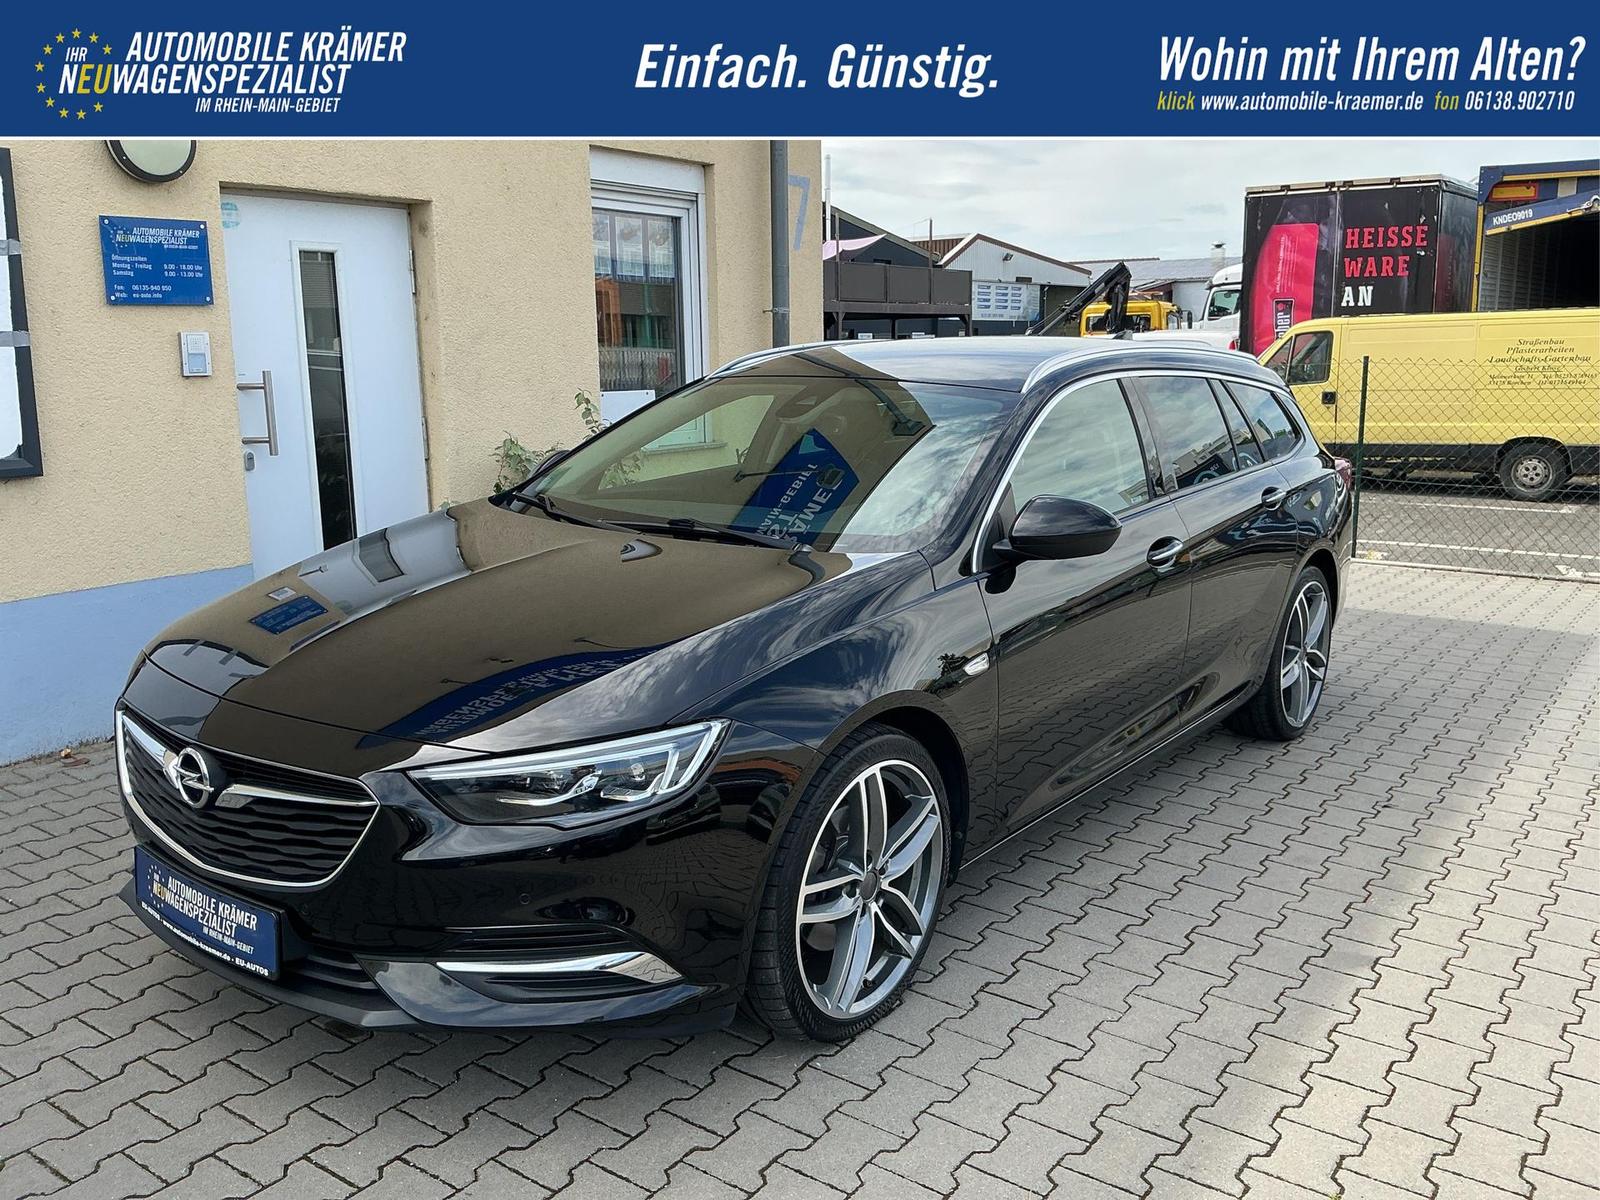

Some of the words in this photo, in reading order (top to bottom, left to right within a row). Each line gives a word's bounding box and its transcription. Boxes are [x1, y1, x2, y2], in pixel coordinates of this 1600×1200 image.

[116, 234, 187, 244] NEUWAGENSPEZIALIST
[132, 227, 173, 237] AUTOMOBILE
[174, 228, 200, 238] KRÄMER
[1345, 225, 1429, 249] HEISSE
[1343, 255, 1410, 278] WARE
[1341, 285, 1374, 307] AN
[1506, 346, 1575, 355] Pflasterarbeiten
[1517, 338, 1565, 347] Straßenbau
[152, 881, 238, 938] NEUWAGENSPEZIALIST
[167, 875, 217, 914] AUTOMOBILE
[218, 902, 258, 931] KRÄMER
[235, 957, 269, 977] EU-AUTOS
